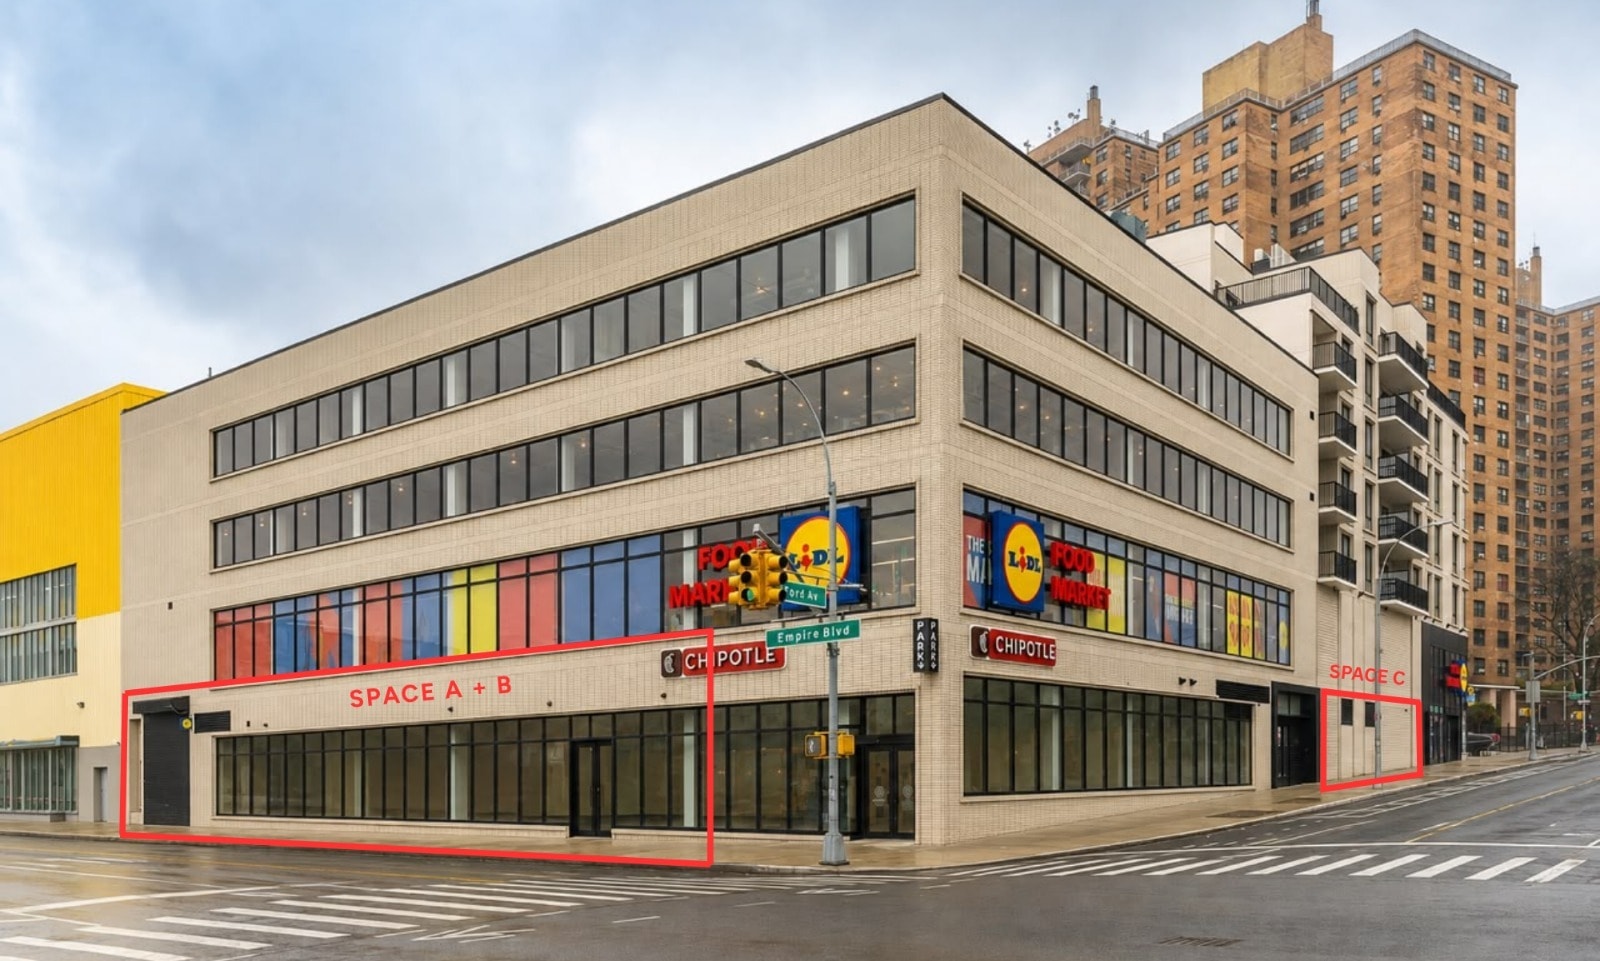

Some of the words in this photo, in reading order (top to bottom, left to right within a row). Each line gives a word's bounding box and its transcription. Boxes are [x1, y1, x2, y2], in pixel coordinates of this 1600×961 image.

[1050, 541, 1095, 574] FOOD
[807, 590, 818, 601] Av
[1050, 576, 1111, 611] MARKET
[777, 629, 819, 643] Empire
[823, 625, 850, 638] Blvd
[916, 621, 925, 660] PARK
[995, 635, 1056, 660] CHIPOTLE
